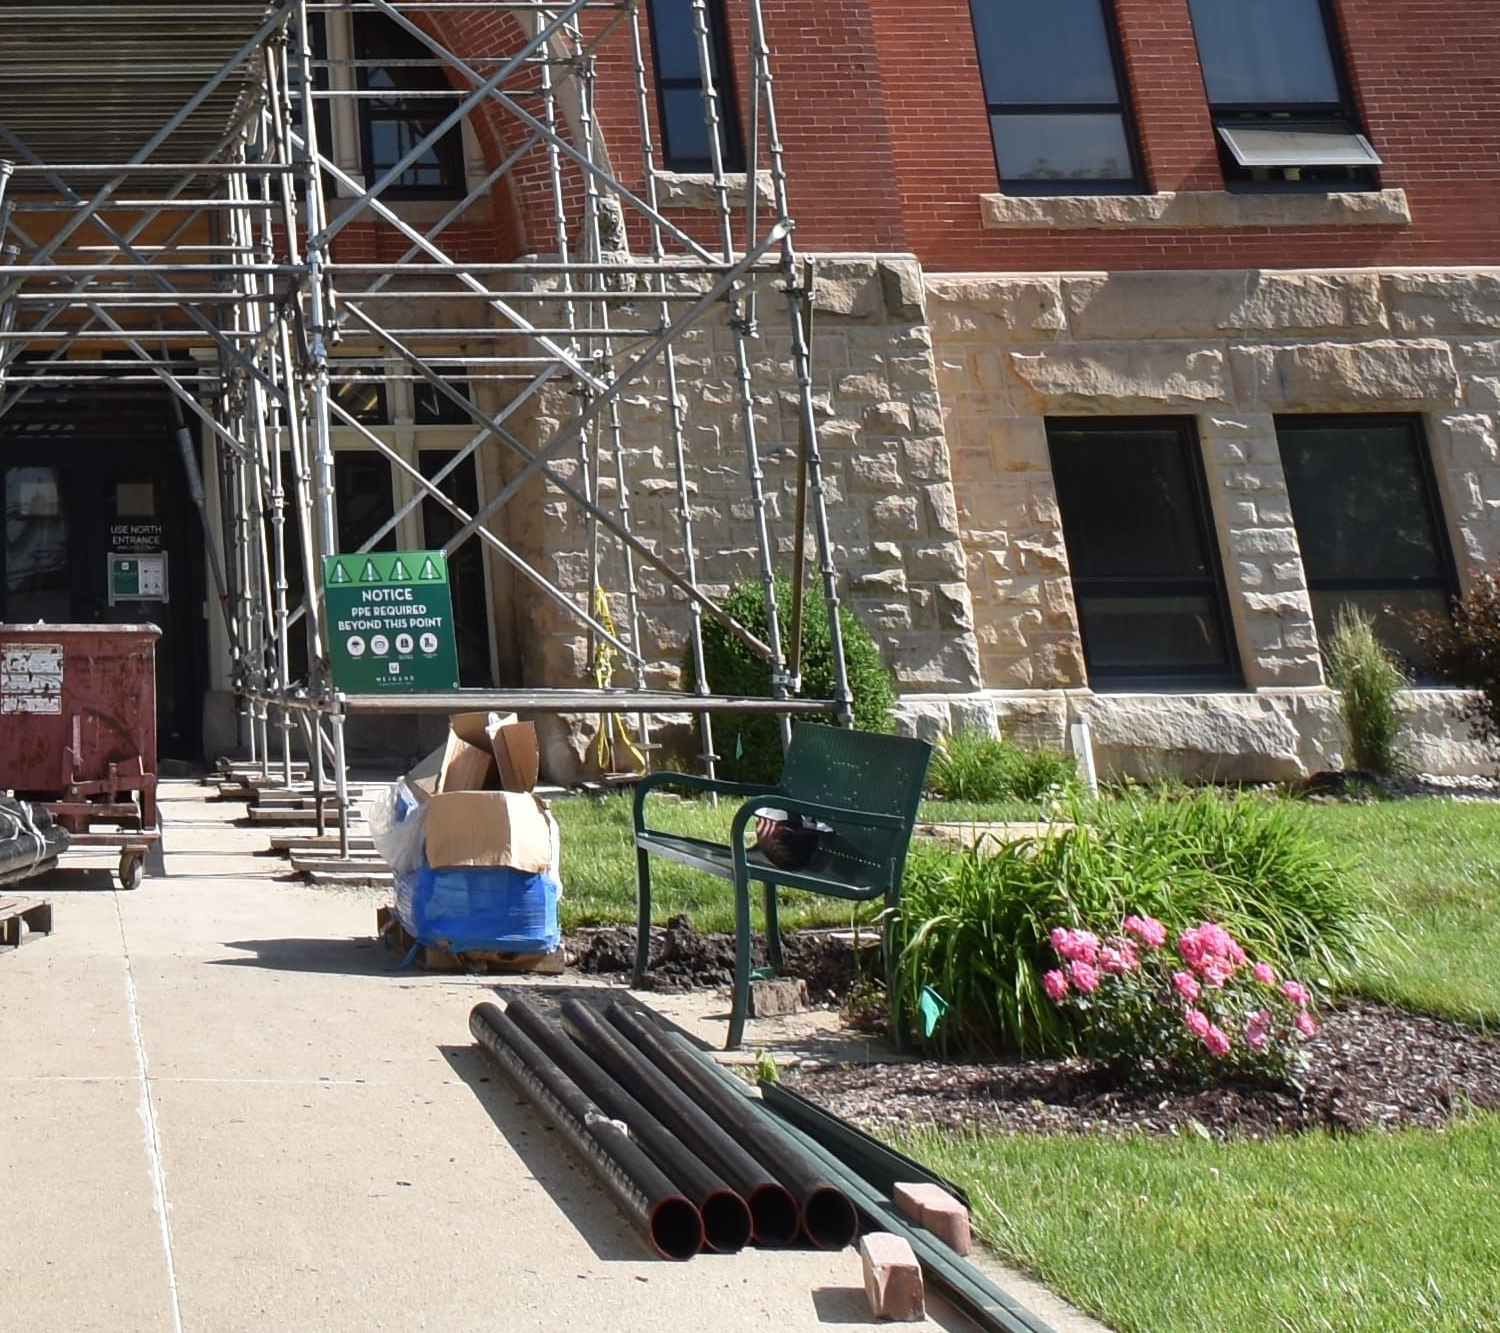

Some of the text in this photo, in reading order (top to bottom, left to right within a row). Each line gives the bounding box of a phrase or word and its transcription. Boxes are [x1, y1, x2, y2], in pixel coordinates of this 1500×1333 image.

[110, 525, 162, 534] USE NORTH
[112, 535, 161, 545] ENTRANCE
[361, 588, 414, 602] NOTICE
[351, 605, 427, 618] PPE REQUIRED
[338, 617, 443, 632] BEYOND THIS POINT
